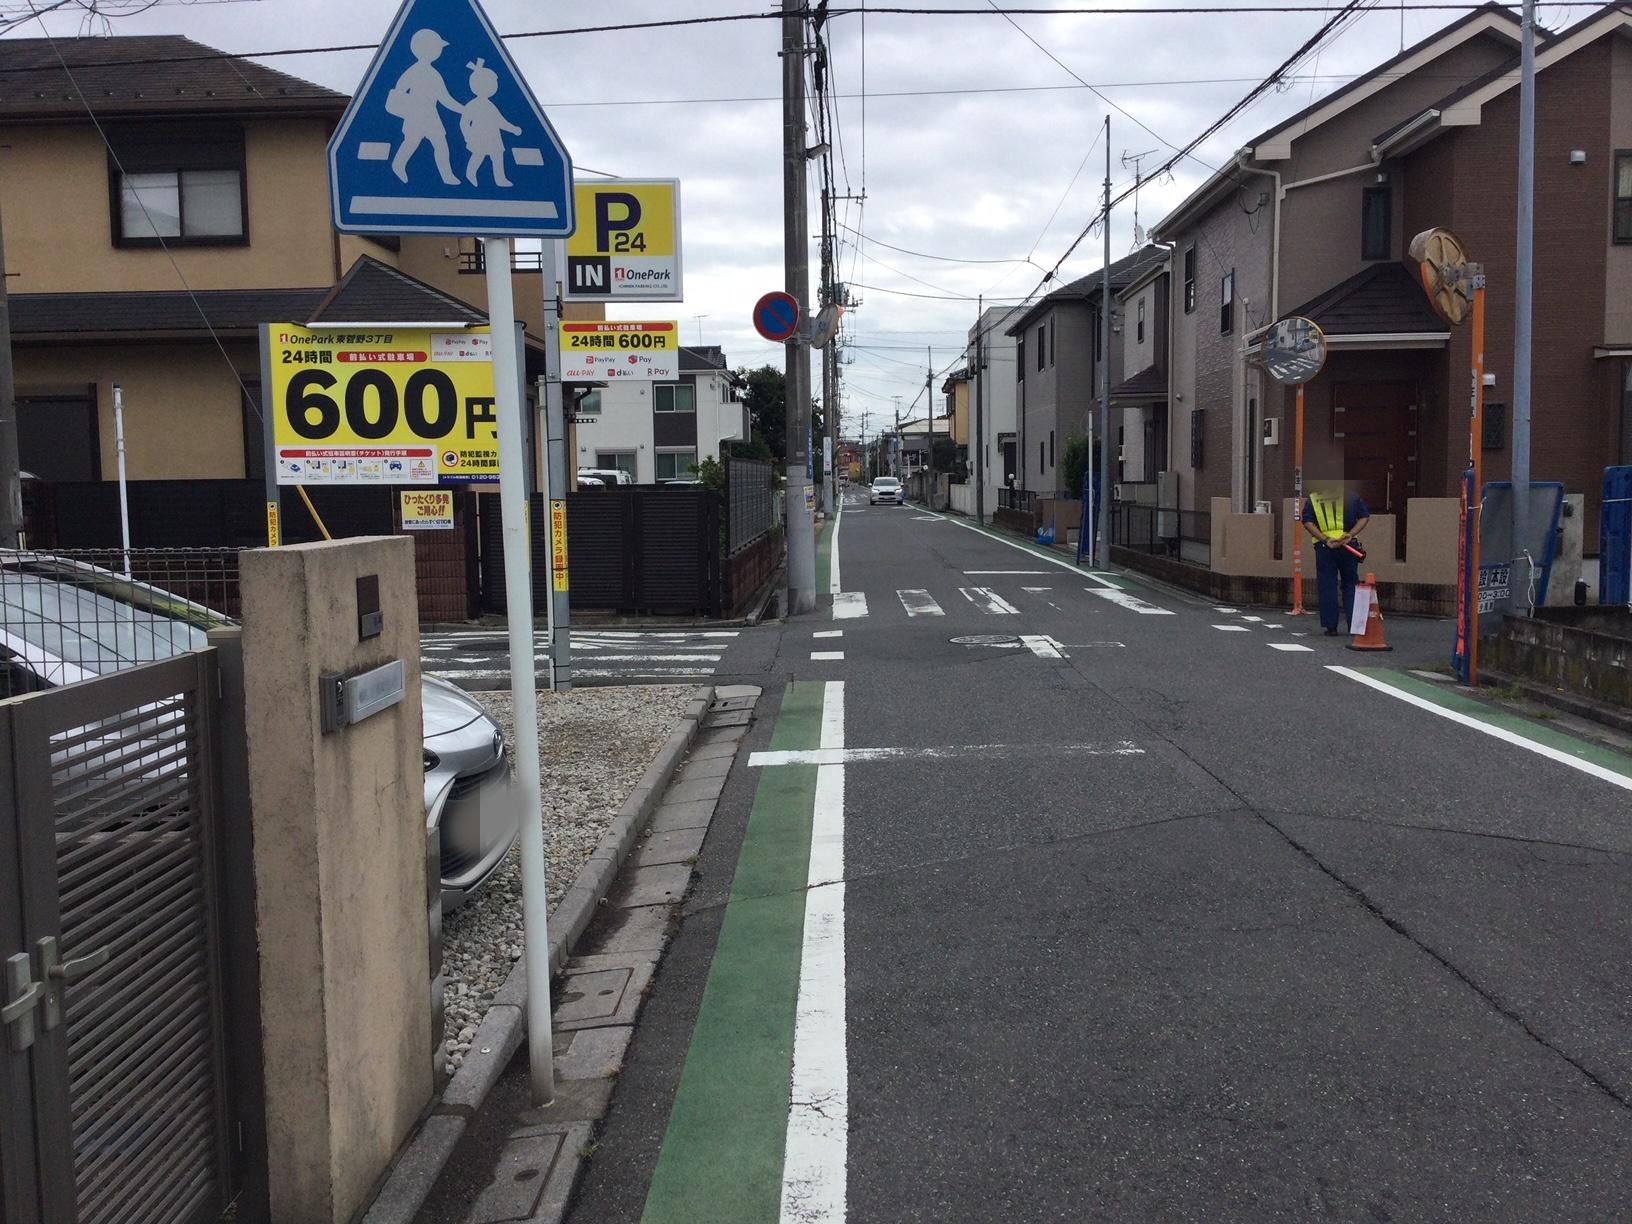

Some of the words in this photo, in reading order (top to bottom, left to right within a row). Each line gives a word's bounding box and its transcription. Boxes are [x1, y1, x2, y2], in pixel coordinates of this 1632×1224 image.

[595, 192, 641, 252] P
[614, 232, 646, 252] 24
[576, 264, 603, 286] IN
[626, 268, 670, 281] OnePark
[290, 334, 334, 345] OnePark
[572, 335, 614, 348] 24時間
[618, 334, 666, 348] 600円
[282, 350, 332, 364] 24時間
[349, 353, 415, 362] 前払い式駐車場
[286, 368, 498, 440] 600円
[404, 494, 449, 504] ひったくり多発
[417, 505, 445, 516] ご用心!!
